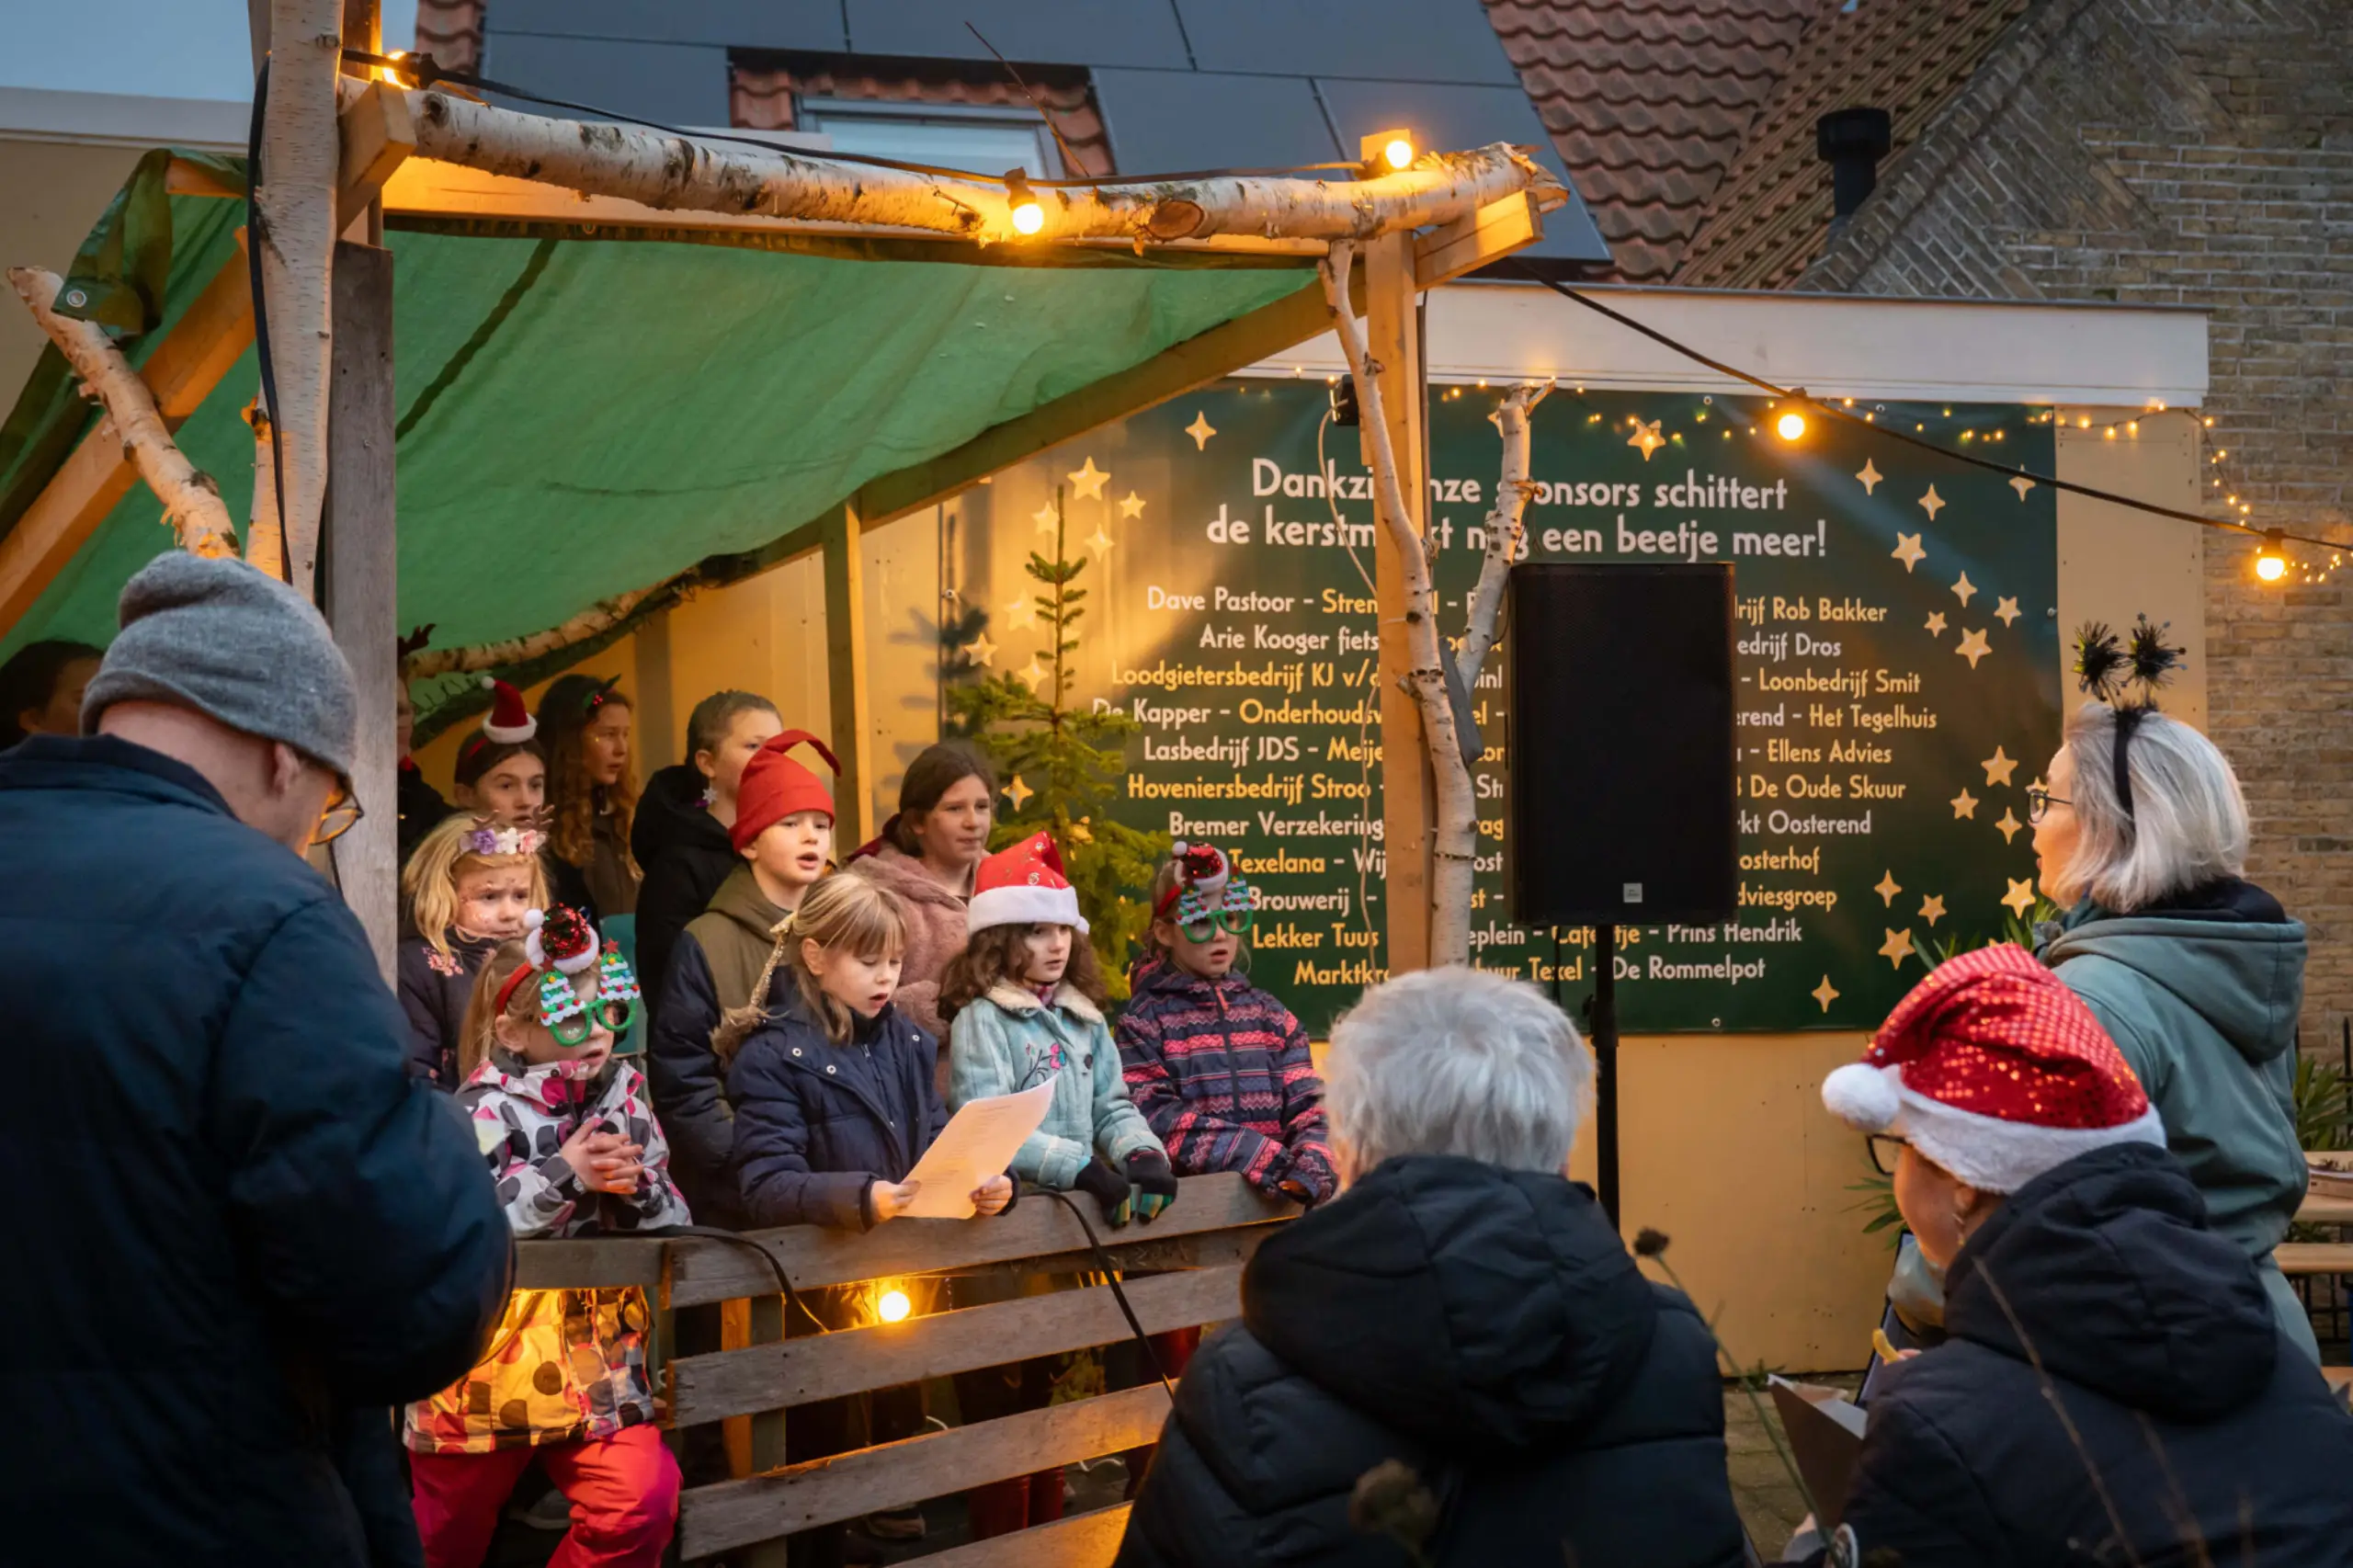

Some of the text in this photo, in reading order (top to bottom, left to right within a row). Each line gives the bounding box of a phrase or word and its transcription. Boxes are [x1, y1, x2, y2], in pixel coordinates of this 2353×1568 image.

[1429, 478, 1482, 504] nze
[1654, 468, 1788, 510] schittert
[1206, 503, 1251, 545] de
[1541, 528, 1603, 552] een
[1617, 513, 1719, 563] beetje
[1732, 518, 1826, 557] meer!
[1147, 585, 1206, 610] Dave
[1214, 585, 1295, 612] Pastoor
[1772, 596, 1811, 620] Rob
[1818, 597, 1888, 622] Bakker
[1199, 623, 1245, 649] Arie
[1254, 624, 1330, 655] Kooger
[1736, 631, 1789, 663] edrijf
[1795, 632, 1842, 657] Dros
[1111, 659, 1304, 694] Loodgietersbedrijf
[1311, 662, 1335, 687] KJ
[1759, 666, 1870, 699] Loonbedrijf
[1874, 668, 1922, 694] Smit
[1132, 697, 1212, 731] Kapper
[1809, 702, 1844, 728] Het
[1849, 704, 1938, 733] Tegelhuis
[1143, 735, 1250, 768] Lasbedrijf
[1256, 736, 1301, 762] JDS
[1767, 738, 1822, 763] Ellens
[1828, 739, 1893, 764] Advies
[1127, 773, 1304, 805] Hoveniersbedrijf
[1311, 773, 1371, 800] Stroo
[1750, 774, 1779, 799] De
[1786, 774, 1842, 799] Oude
[1848, 774, 1907, 800] Skuur
[1168, 811, 1250, 836] Bremer
[1768, 809, 1872, 835] Oosterend
[1227, 847, 1326, 873] Texelana
[1247, 885, 1350, 917] Brouwerij
[1252, 923, 1324, 949] Lekker
[1722, 917, 1802, 943] Hendrik
[1613, 955, 1642, 981] De
[1648, 953, 1767, 985] Rommelpot
